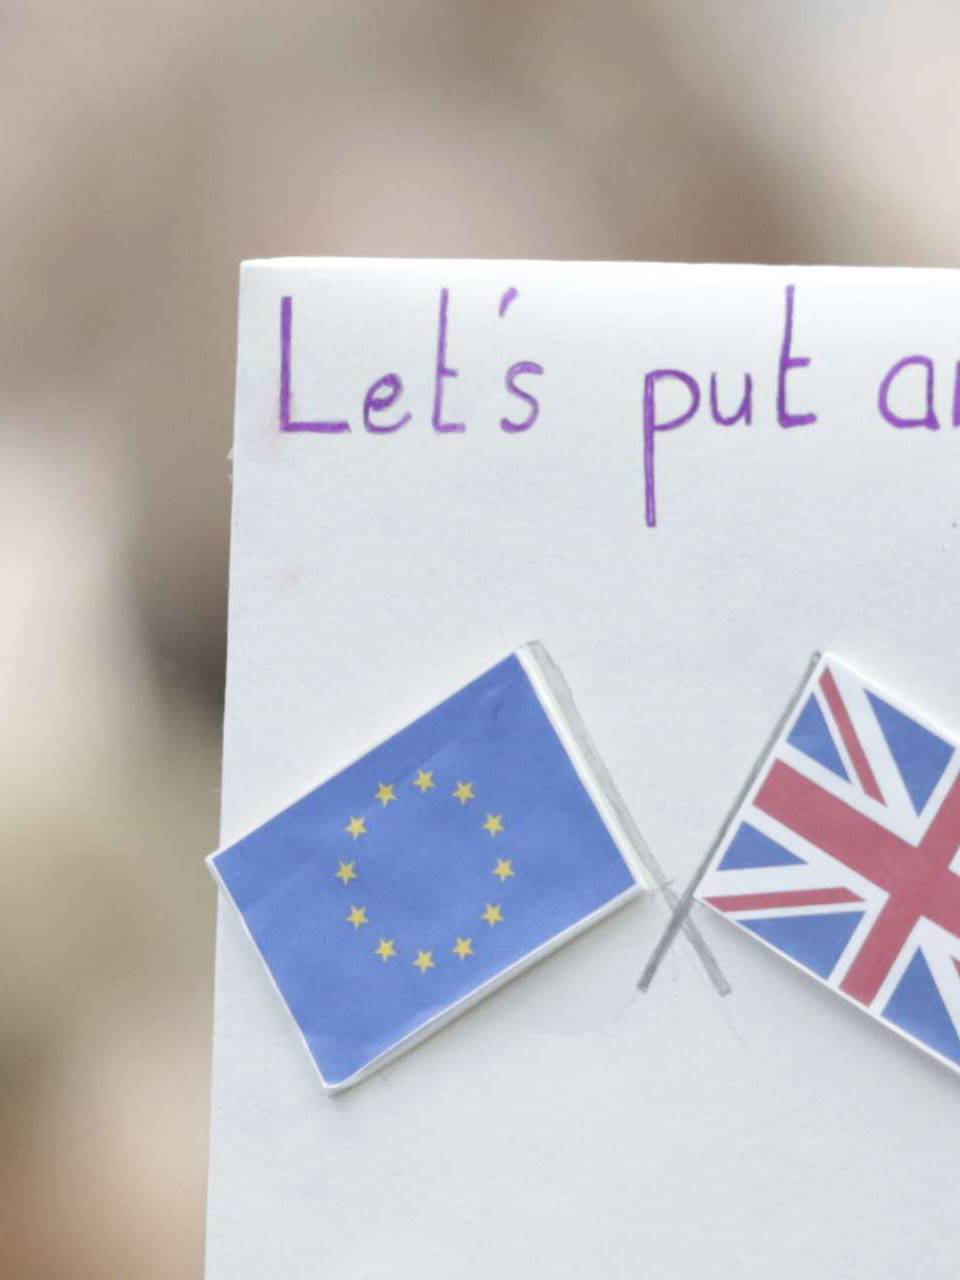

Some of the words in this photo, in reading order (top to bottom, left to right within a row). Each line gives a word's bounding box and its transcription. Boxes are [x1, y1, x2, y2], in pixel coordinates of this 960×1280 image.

[279, 286, 543, 434] Let's
[643, 284, 817, 528] put
[877, 354, 960, 431] a
